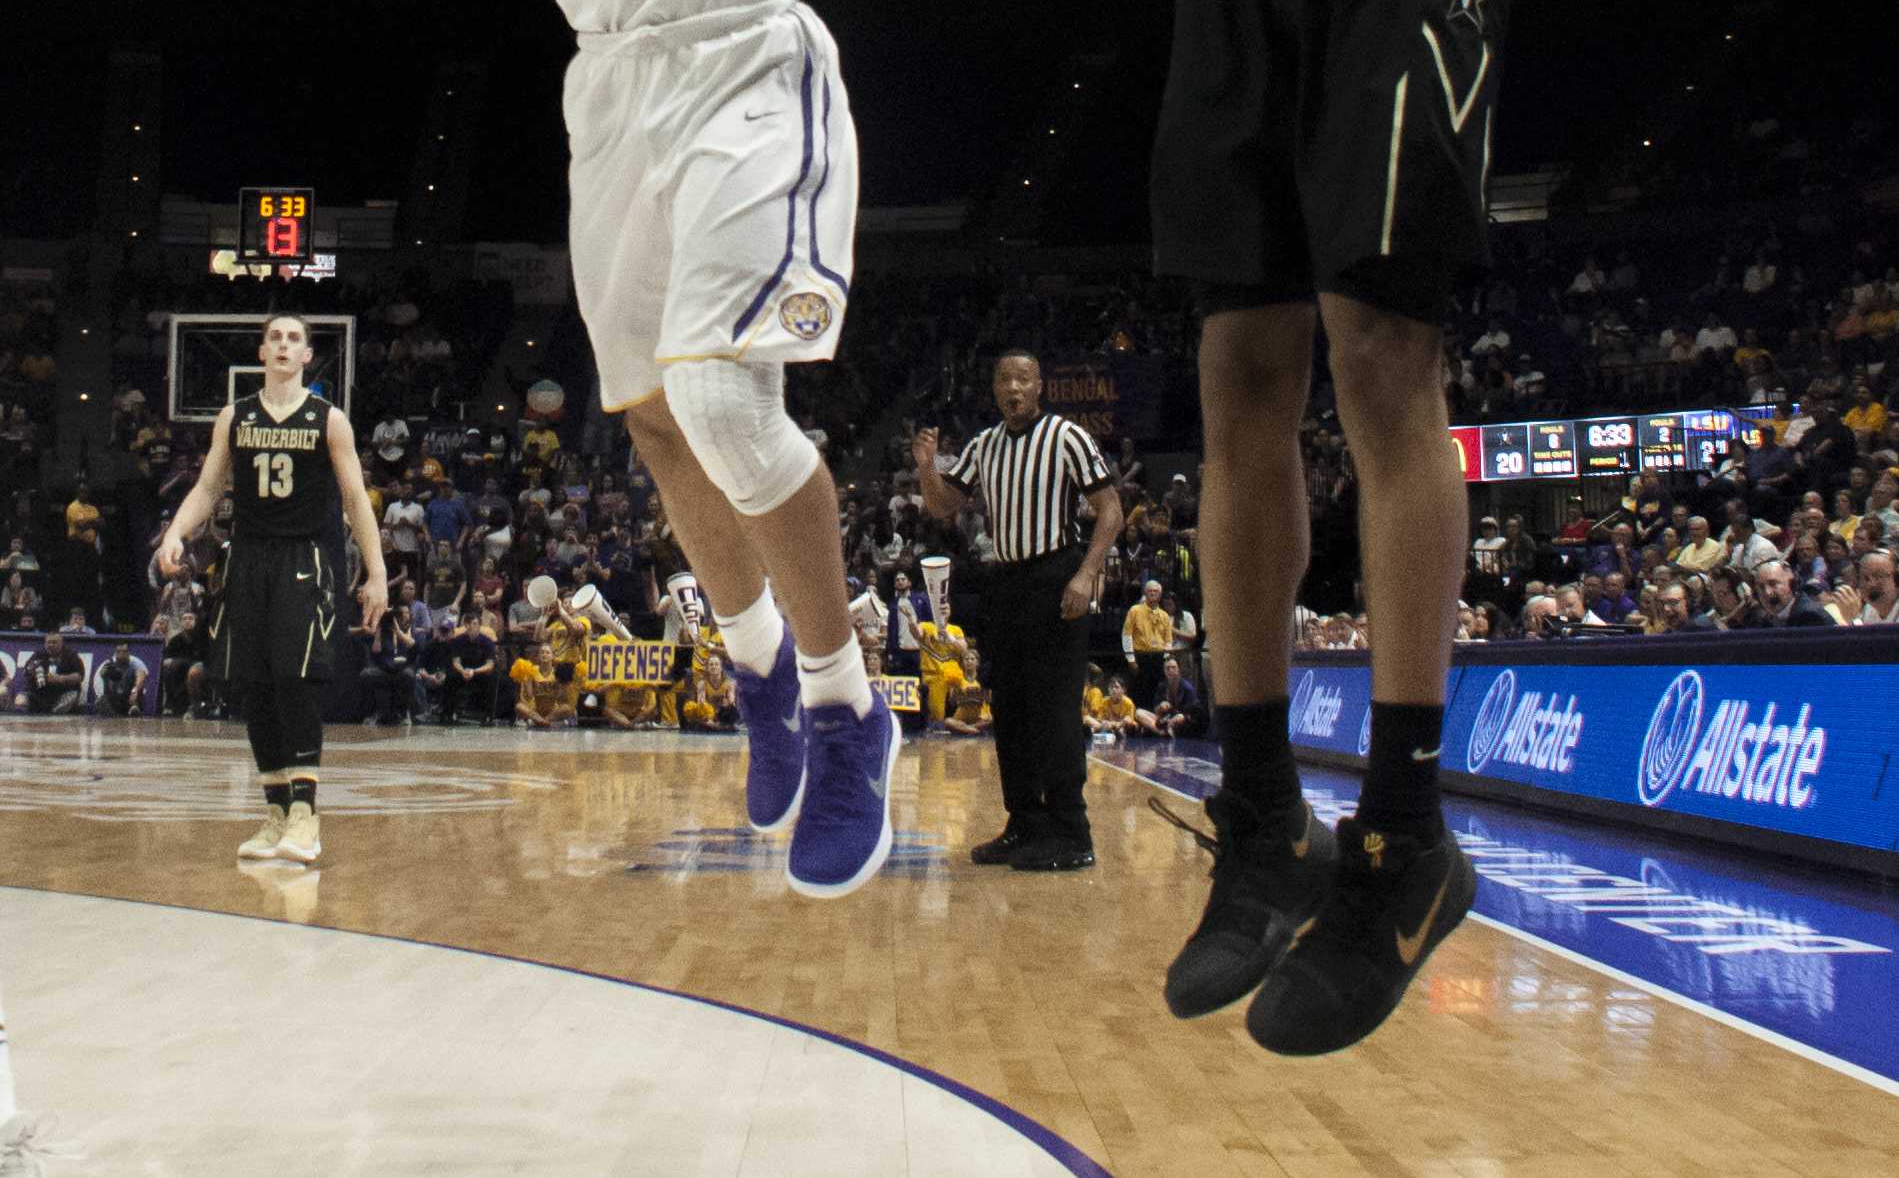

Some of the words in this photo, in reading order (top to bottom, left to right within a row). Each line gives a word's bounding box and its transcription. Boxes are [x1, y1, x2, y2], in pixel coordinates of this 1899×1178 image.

[266, 217, 298, 256] 13
[236, 426, 320, 450] VANDERBILT
[253, 452, 294, 498] 13
[1495, 451, 1523, 474] 20
[588, 645, 673, 681] DEFENSE
[1297, 685, 1343, 738] Allstate
[1493, 693, 1585, 773] Allstate
[1681, 698, 1827, 808] Allstate
